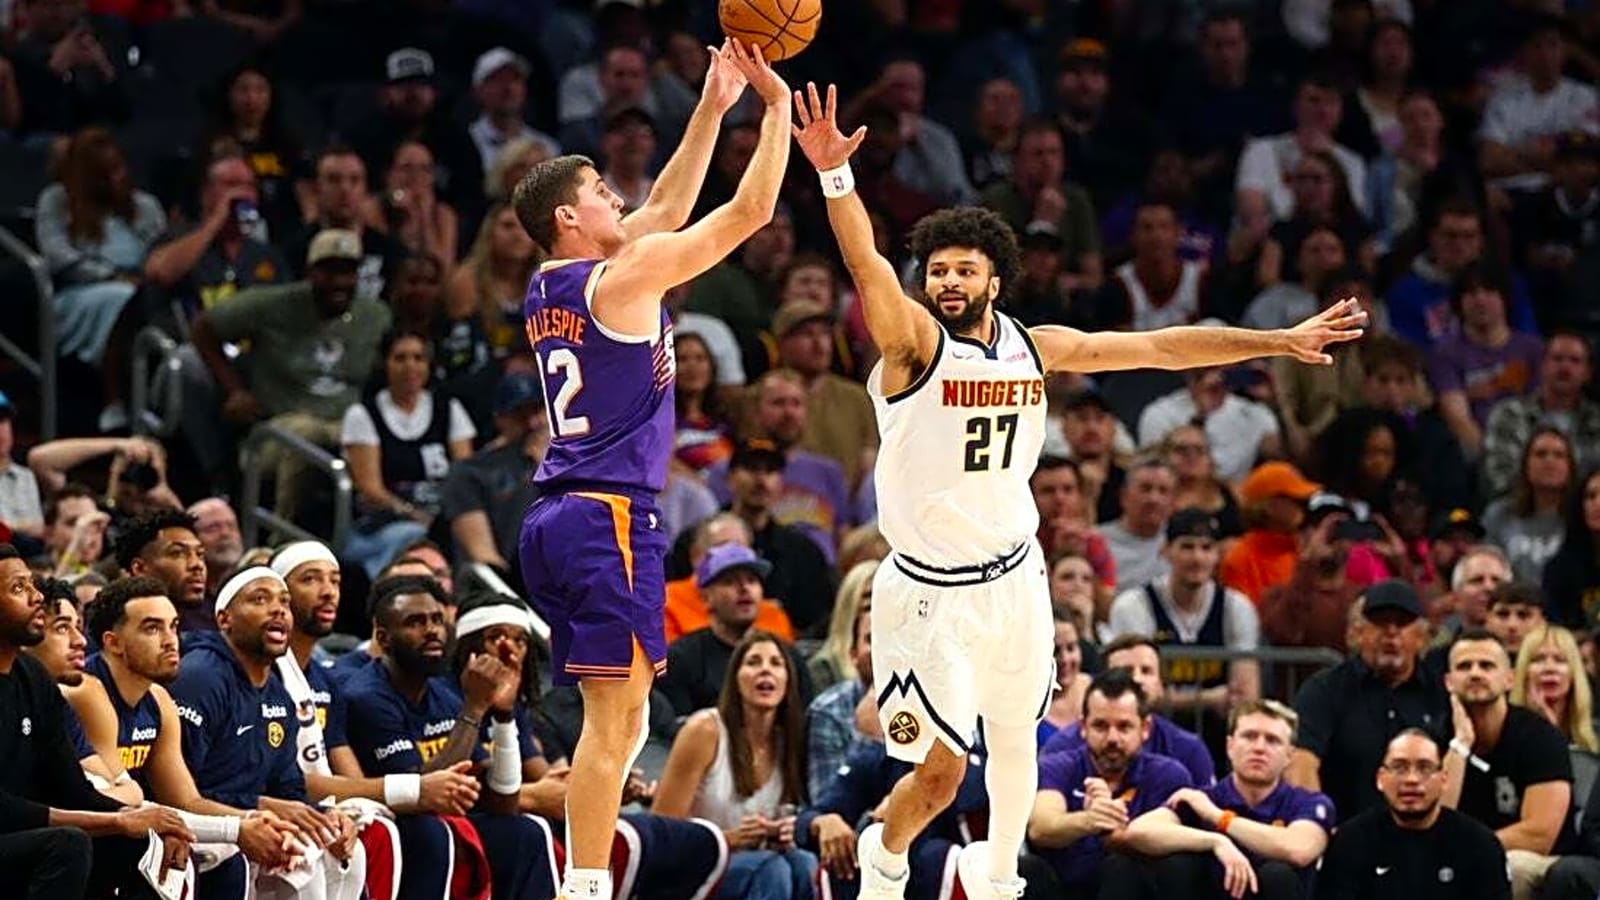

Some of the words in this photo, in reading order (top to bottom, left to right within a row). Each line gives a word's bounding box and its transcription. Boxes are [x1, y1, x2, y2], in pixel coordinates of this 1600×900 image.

[526, 308, 585, 346] ILLESPIE
[942, 379, 1043, 407] NUGGETS
[964, 413, 1019, 472] 27
